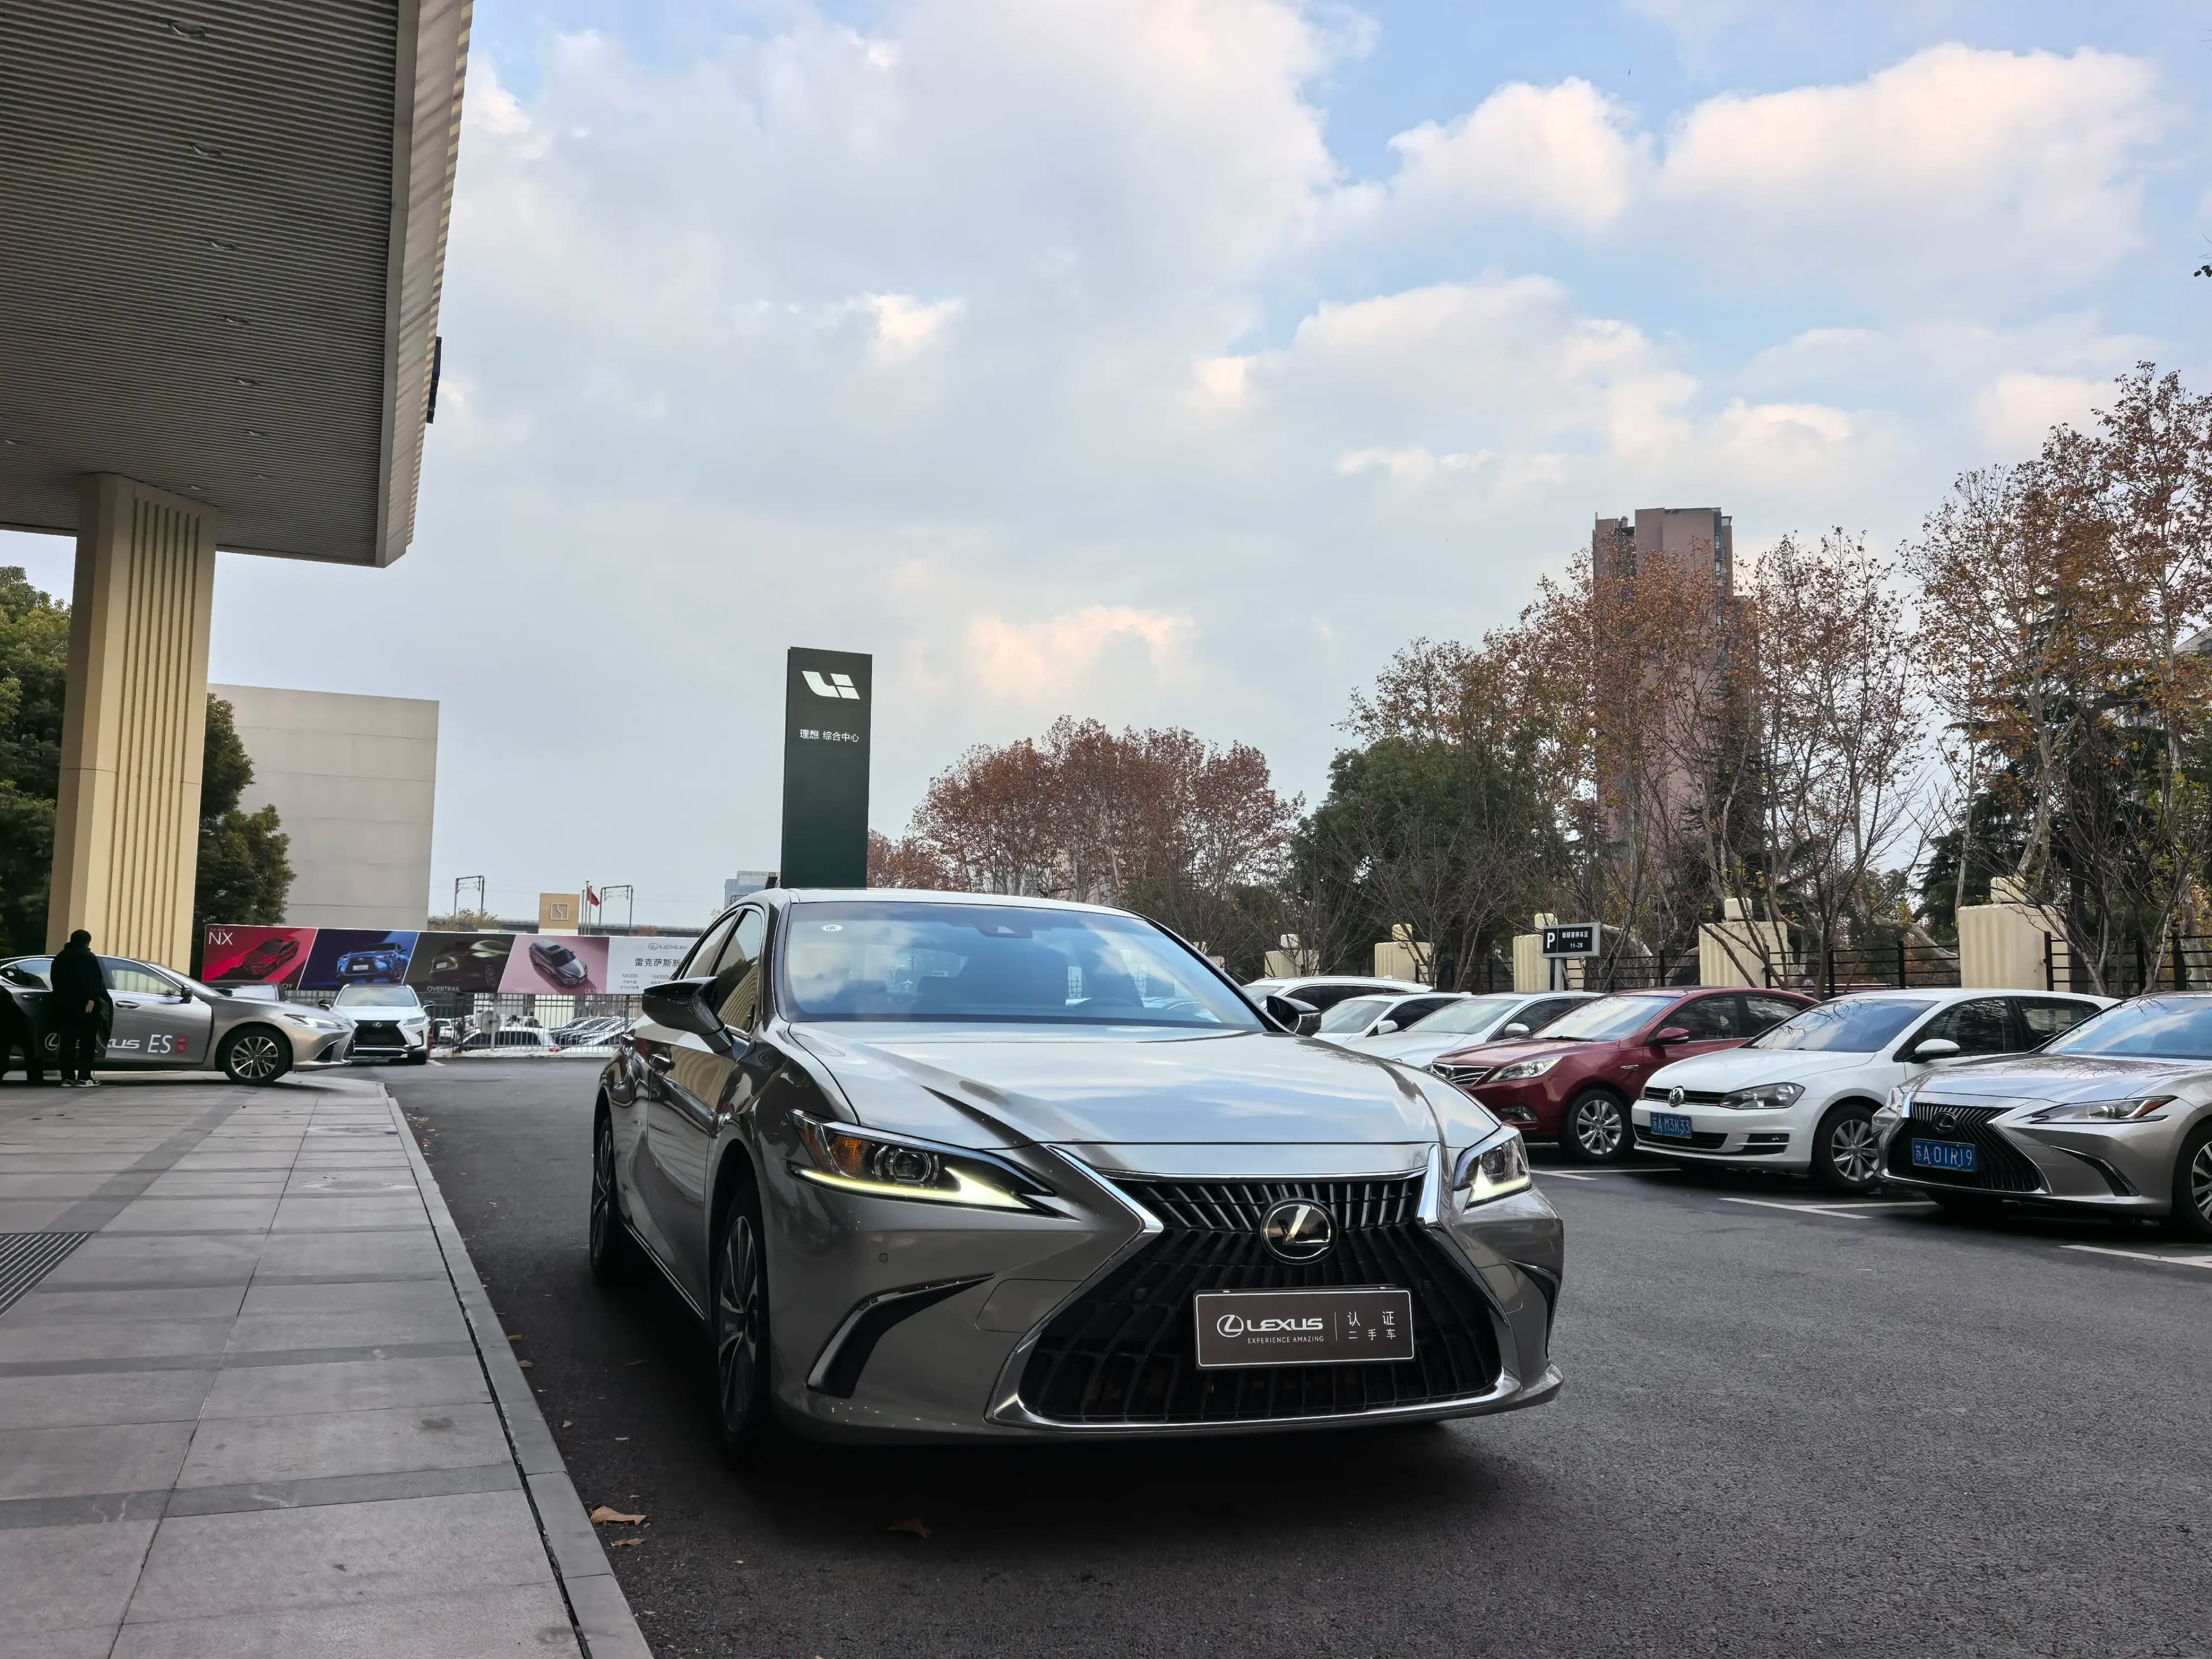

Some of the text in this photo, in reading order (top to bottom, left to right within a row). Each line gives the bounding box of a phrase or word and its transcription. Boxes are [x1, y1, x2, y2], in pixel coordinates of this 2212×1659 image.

[799, 729, 859, 743] 理想 综合中心
[208, 931, 233, 946] NX
[1547, 932, 1555, 949] P
[147, 1034, 173, 1054] ES
[1247, 1317, 1323, 1332] LEXUS
